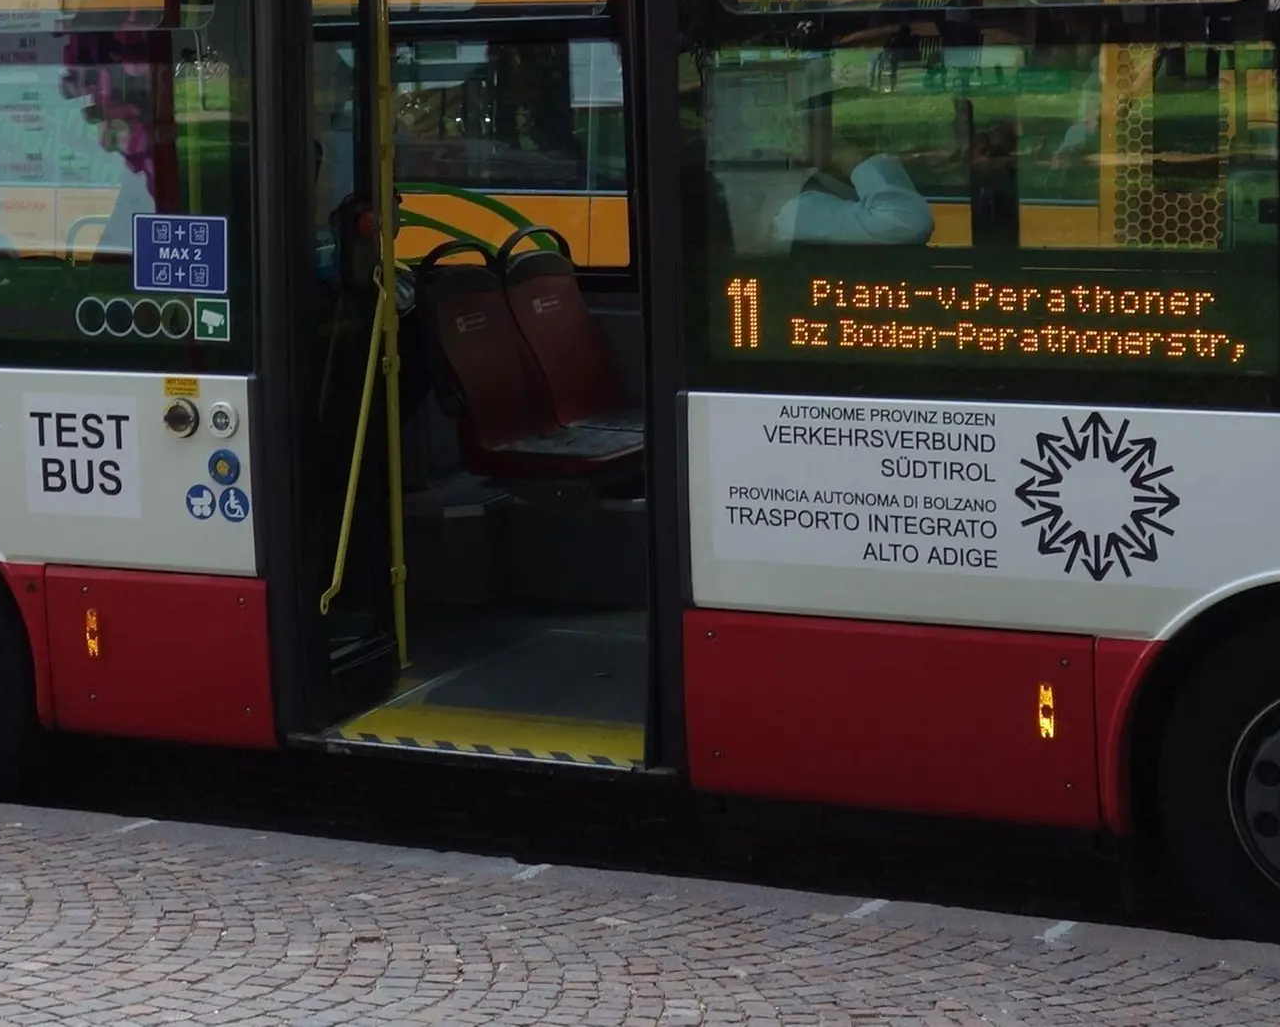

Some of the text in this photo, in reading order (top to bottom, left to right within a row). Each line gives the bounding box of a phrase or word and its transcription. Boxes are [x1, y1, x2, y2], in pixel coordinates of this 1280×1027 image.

[159, 247, 202, 261] MAX 2
[812, 279, 1216, 316] Piani-v.Perathoner
[727, 278, 760, 349] 11
[791, 318, 829, 347] Bz
[29, 411, 131, 450] TEST
[780, 405, 996, 427] AUTONOME PROVINZ BOZEN
[763, 424, 996, 453] VERKEHRSVERBUND
[41, 457, 123, 497] BUS
[880, 456, 997, 483] SÜDTIROL
[729, 486, 997, 513] PROVINCIA AUTONOMA DI BOLZANO
[725, 506, 997, 540] TRASPORTO INTEGRATO
[862, 542, 998, 568] ALTO ADIGE
